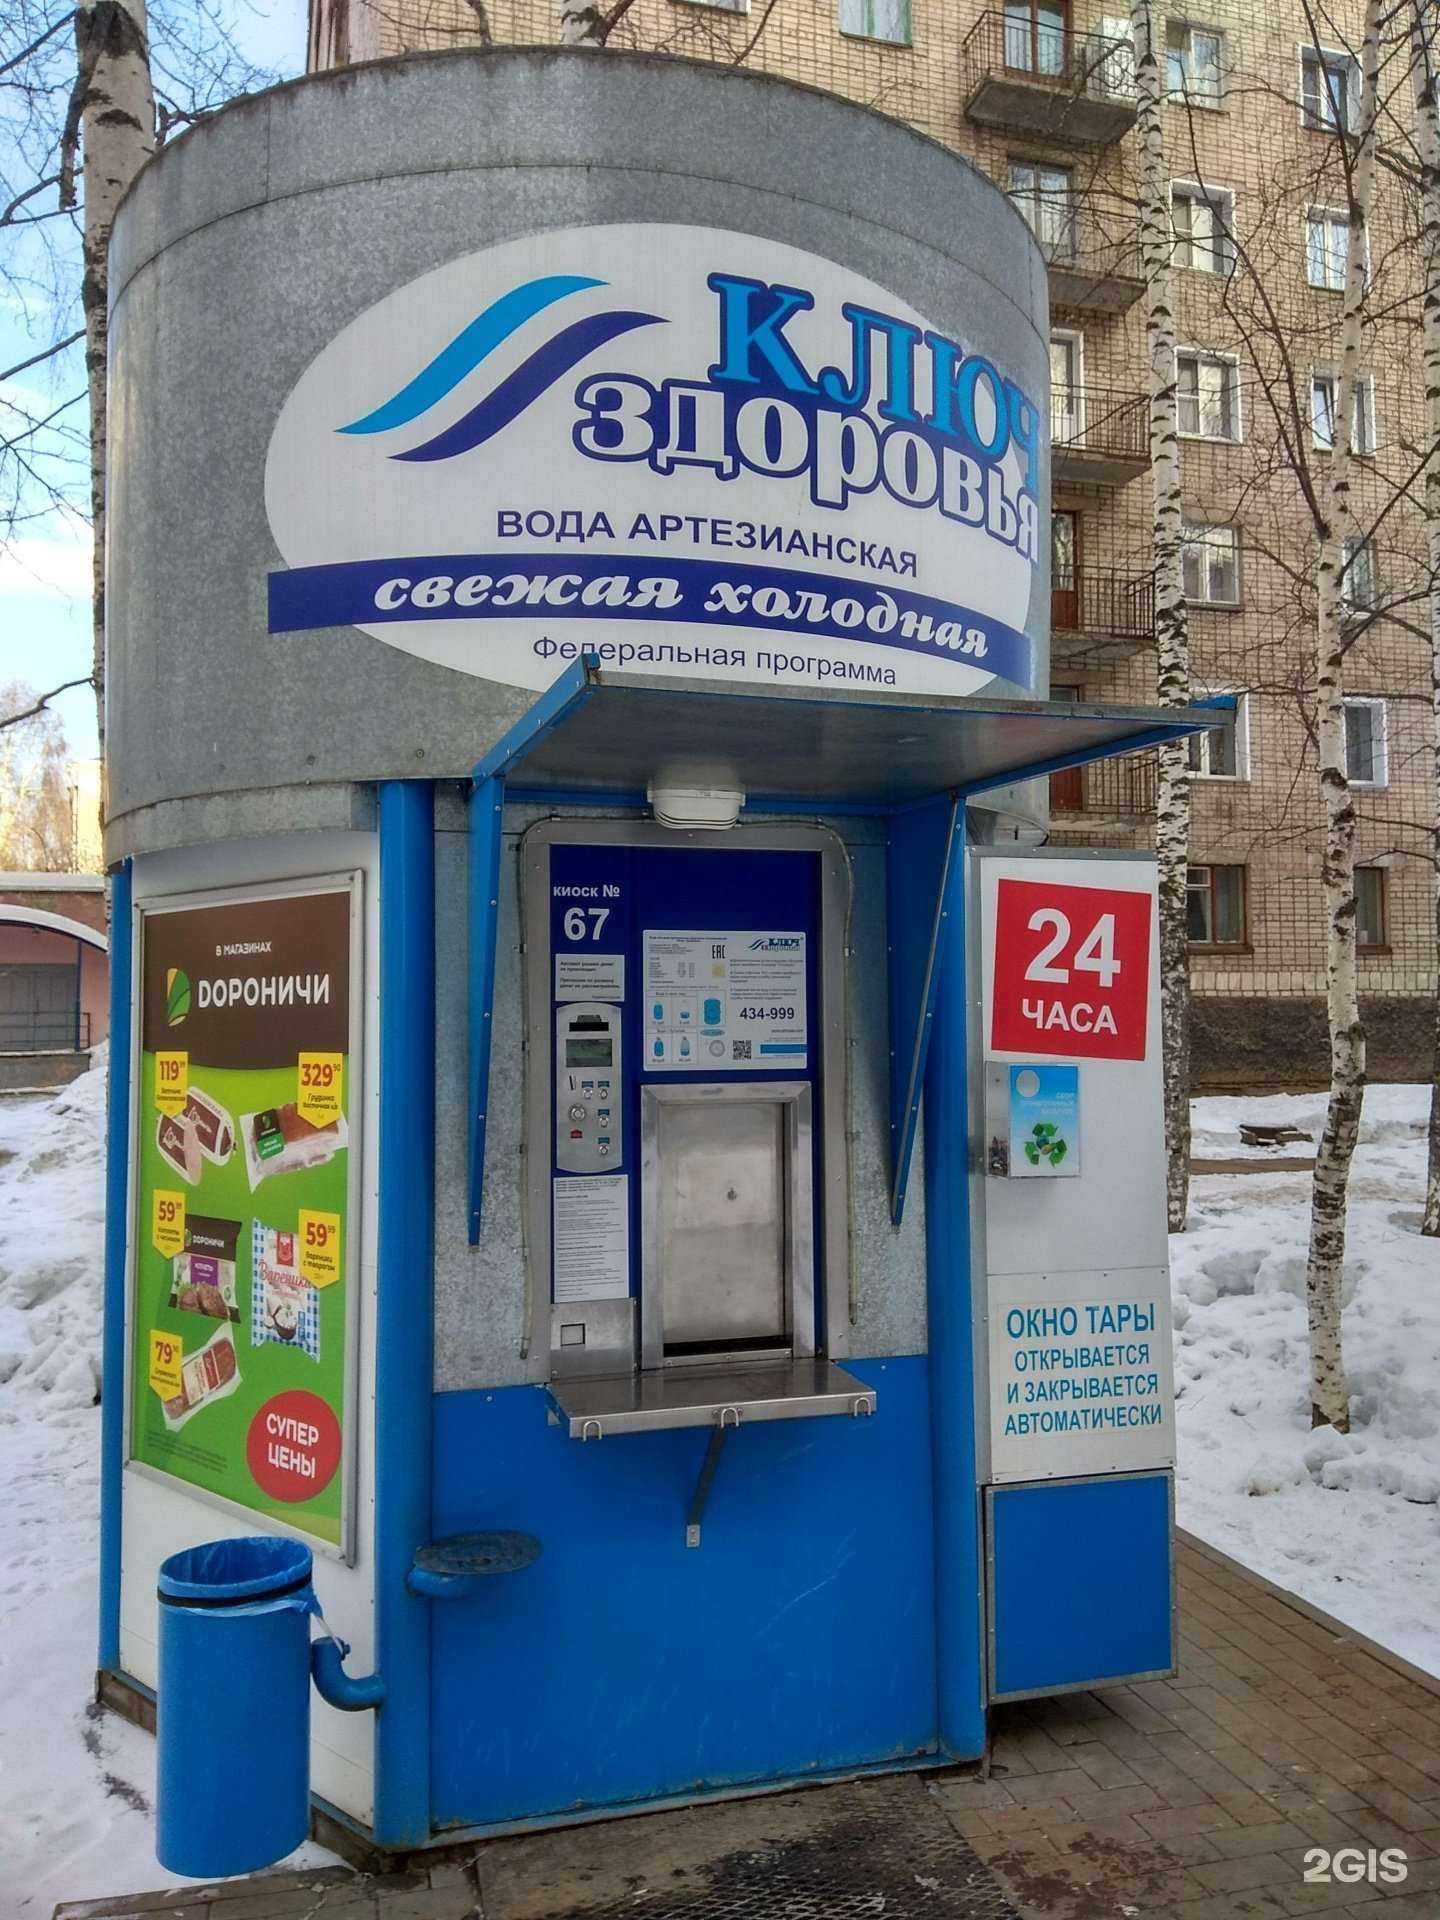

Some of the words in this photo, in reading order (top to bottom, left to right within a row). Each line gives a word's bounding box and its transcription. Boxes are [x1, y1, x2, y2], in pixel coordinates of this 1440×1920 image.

[497, 511, 615, 543] ВОДА
[628, 513, 918, 578] АРТЕЗИАНСКАЯ
[374, 573, 684, 611] свежая
[704, 580, 989, 658] холодная
[757, 650, 897, 686] программа
[553, 886, 598, 898] киоск
[603, 884, 620, 898] №
[563, 907, 610, 940] 67
[223, 941, 272, 955] МАГАЗИНАХ
[1024, 908, 1121, 988] 24
[740, 1007, 794, 1020] 434-999
[1022, 998, 1118, 1035] ЧАСА
[301, 1063, 333, 1087] 329
[158, 1200, 176, 1222] 59
[306, 1222, 328, 1247] 59
[1006, 1306, 1078, 1339] ОКНО
[1085, 1303, 1154, 1334] ТАРЫ
[155, 1341, 172, 1364] 79
[1015, 1344, 1150, 1372] ОТКРЫВАЕТСЯ
[1007, 1383, 1019, 1404] И
[1024, 1374, 1158, 1403] ЗАКРЫВАЕТСЯ
[266, 1412, 319, 1447] СУПЕР
[1005, 1404, 1162, 1436] АВТОМАТИЧЕСКИ
[268, 1442, 316, 1479] ЦЕНЫ
